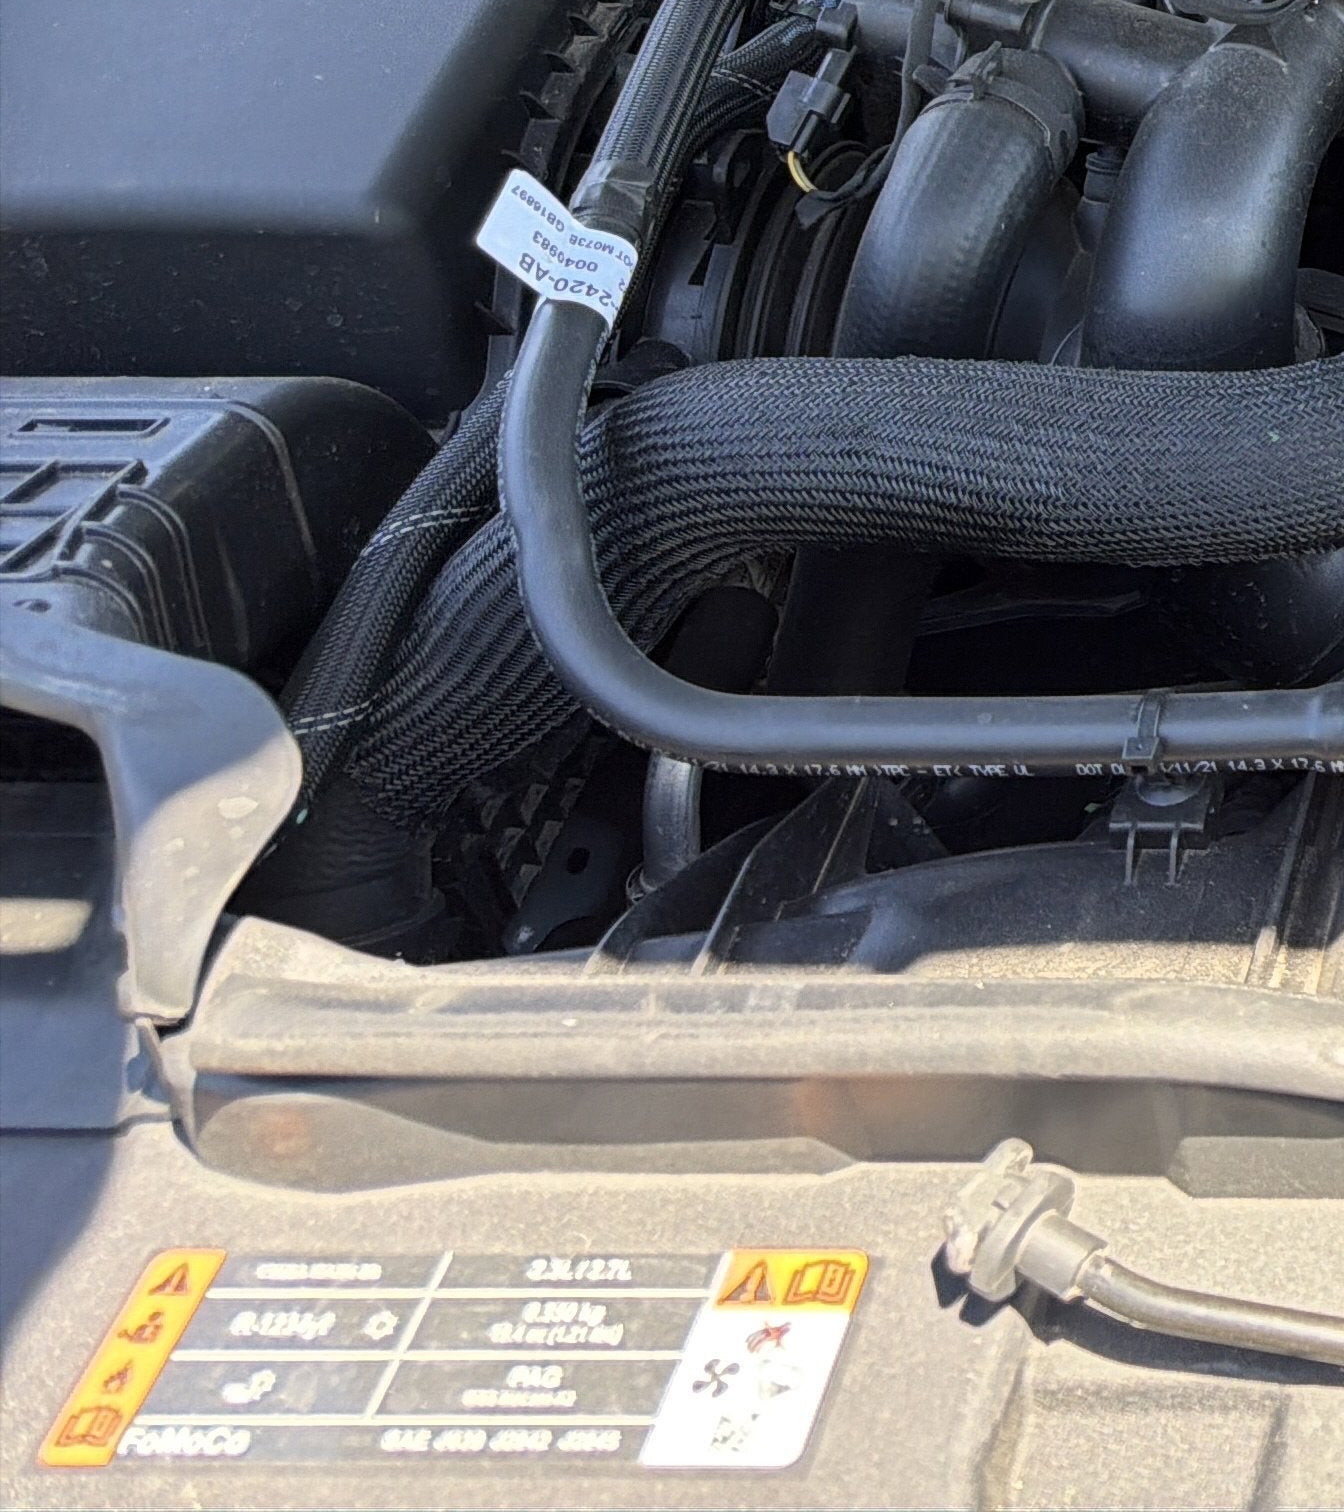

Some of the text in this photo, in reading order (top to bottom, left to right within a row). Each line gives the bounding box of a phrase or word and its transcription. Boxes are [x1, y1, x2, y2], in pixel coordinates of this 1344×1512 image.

[533, 230, 599, 273] 0040983
[519, 252, 619, 311] -2420-AB
[804, 763, 841, 776] 17.6
[1228, 758, 1266, 772] 14.3
[1291, 757, 1326, 773] 17.6
[116, 1426, 252, 1457] FoMoCo
